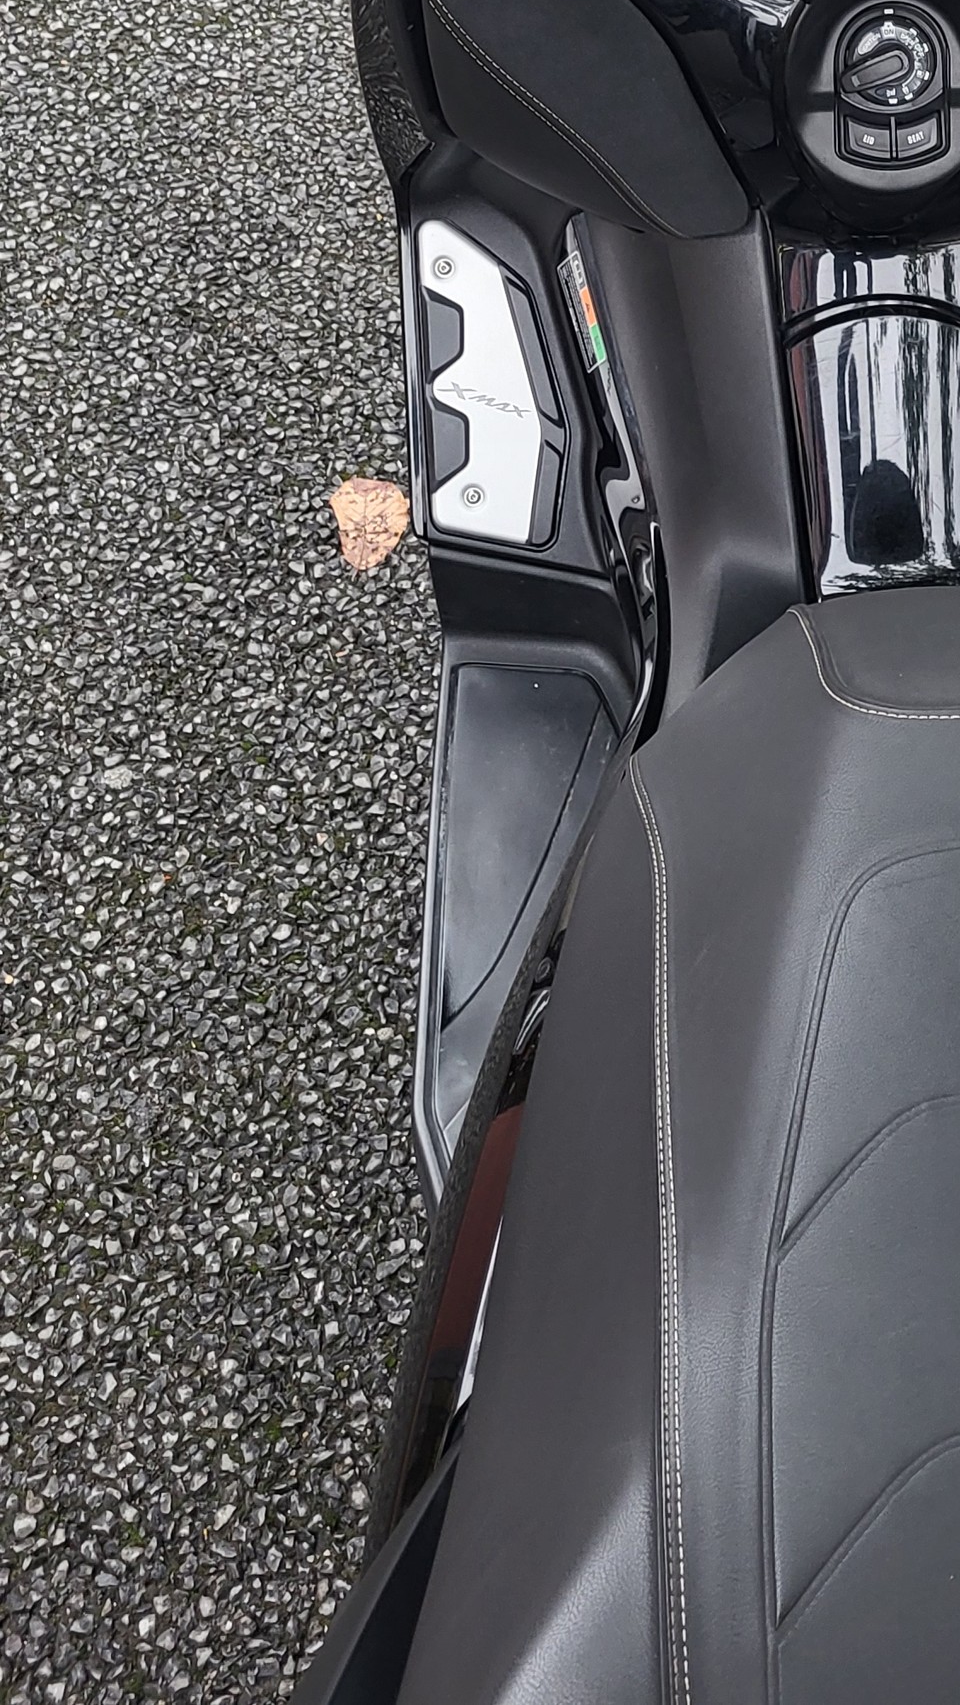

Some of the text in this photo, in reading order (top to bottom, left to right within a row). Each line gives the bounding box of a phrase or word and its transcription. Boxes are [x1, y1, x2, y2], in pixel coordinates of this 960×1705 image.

[883, 28, 895, 36] ON
[862, 134, 875, 145] LID
[907, 131, 925, 145] SEAT
